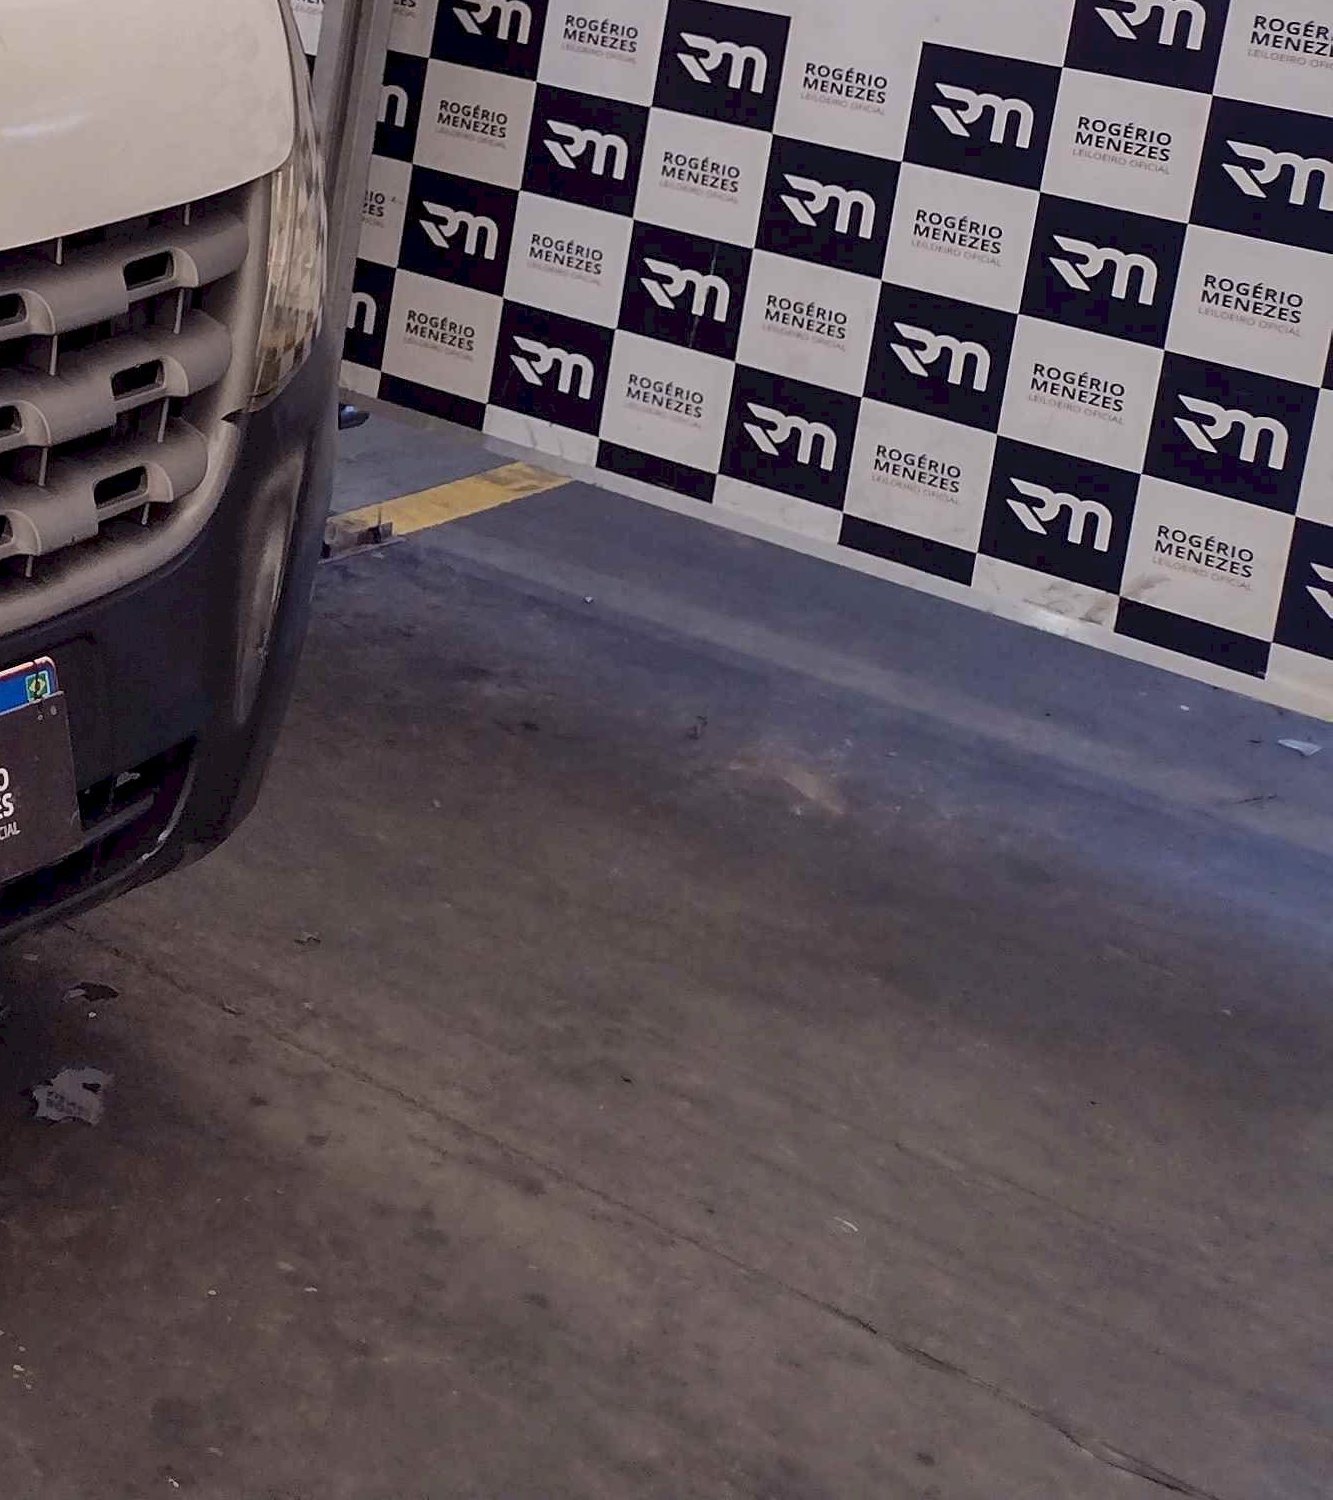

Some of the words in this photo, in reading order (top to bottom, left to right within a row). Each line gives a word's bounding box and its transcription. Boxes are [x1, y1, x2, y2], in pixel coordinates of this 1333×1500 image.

[563, 28, 637, 52] MENEZES
[565, 15, 638, 39] ROGÉRIO
[1075, 132, 1170, 161] MENEZES
[1078, 116, 1171, 146] ROGÉRIO
[914, 223, 1001, 254] MENEZES
[916, 209, 1002, 239] ROGÉRIO
[1204, 274, 1303, 307] ROGÉRIO
[767, 295, 847, 325] ROGÉRIO
[1201, 290, 1301, 323] MENEZES
[765, 308, 845, 339] MENEZES
[1031, 377, 1123, 412] MENEZES
[1033, 363, 1124, 396] ROGÉRIO
[1155, 540, 1253, 578] MENEZES
[1157, 525, 1253, 562] ROGÉRIO
